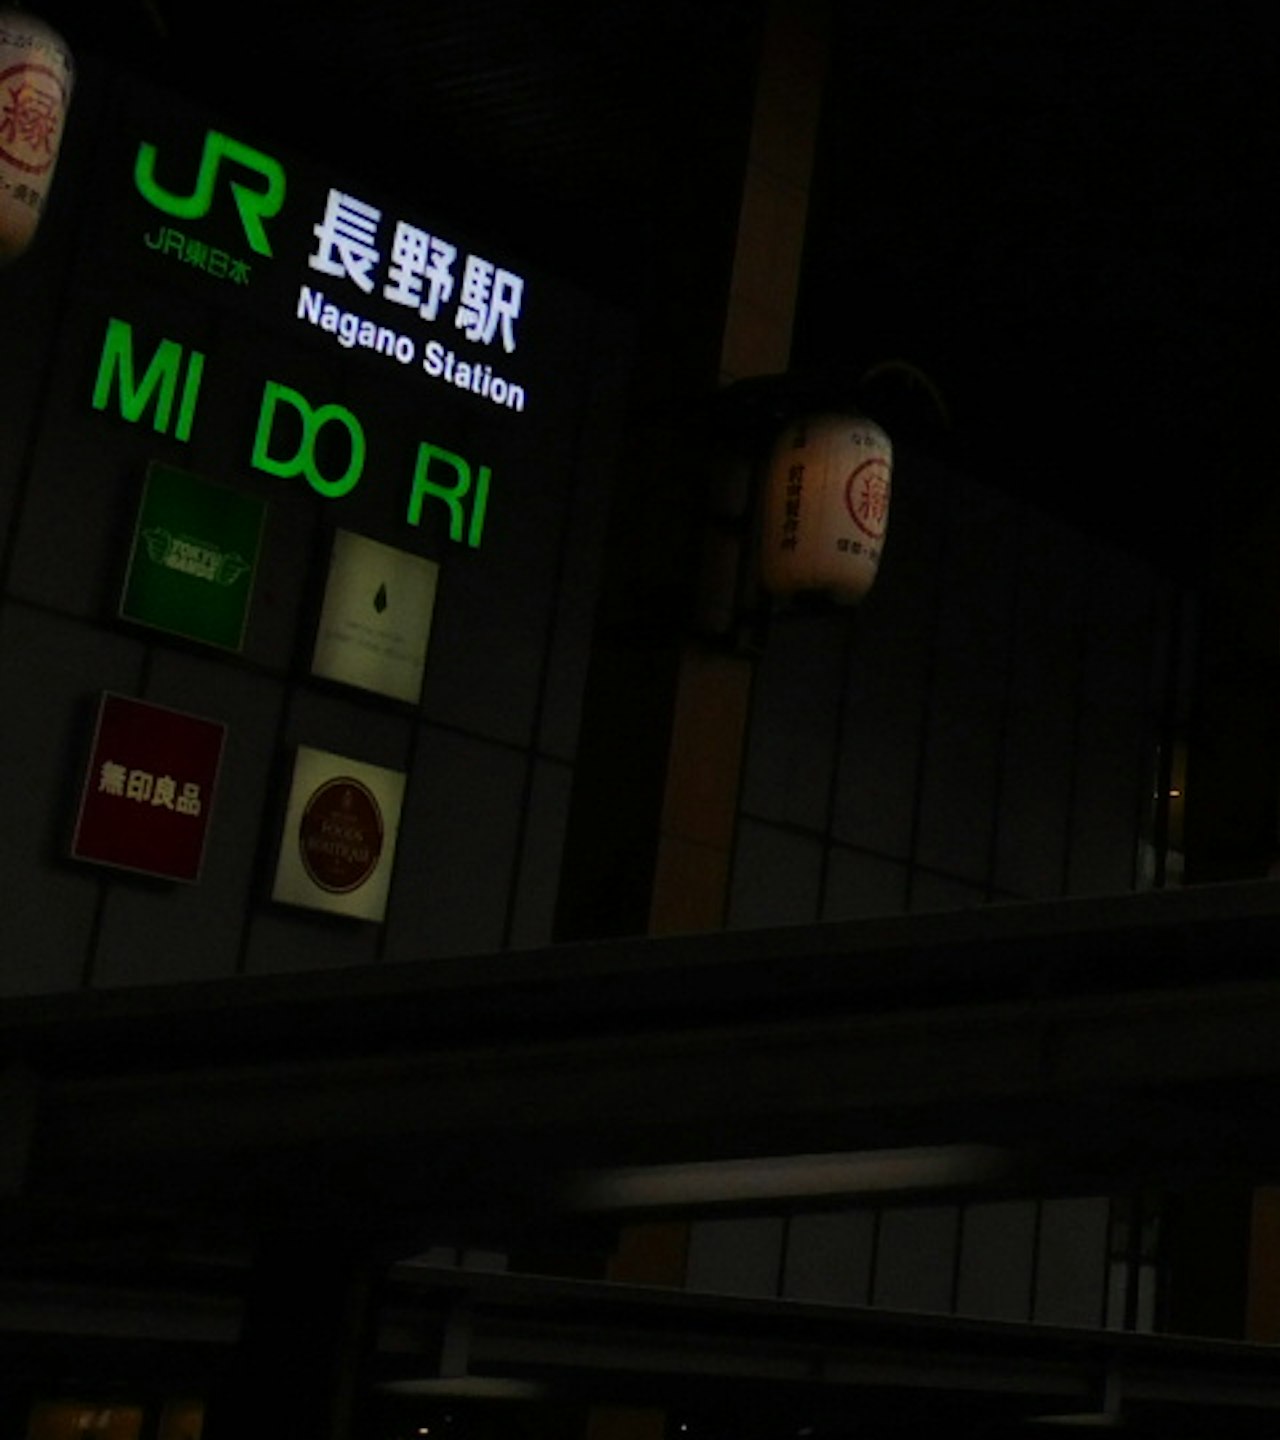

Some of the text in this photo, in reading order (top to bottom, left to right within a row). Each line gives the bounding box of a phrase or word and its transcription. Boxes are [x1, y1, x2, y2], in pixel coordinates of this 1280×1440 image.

[134, 130, 286, 258] JR
[142, 230, 252, 286] JR東日本
[308, 187, 525, 354] 長野駅
[296, 285, 526, 412] Nagano Station
[98, 759, 203, 818] 無印良品
